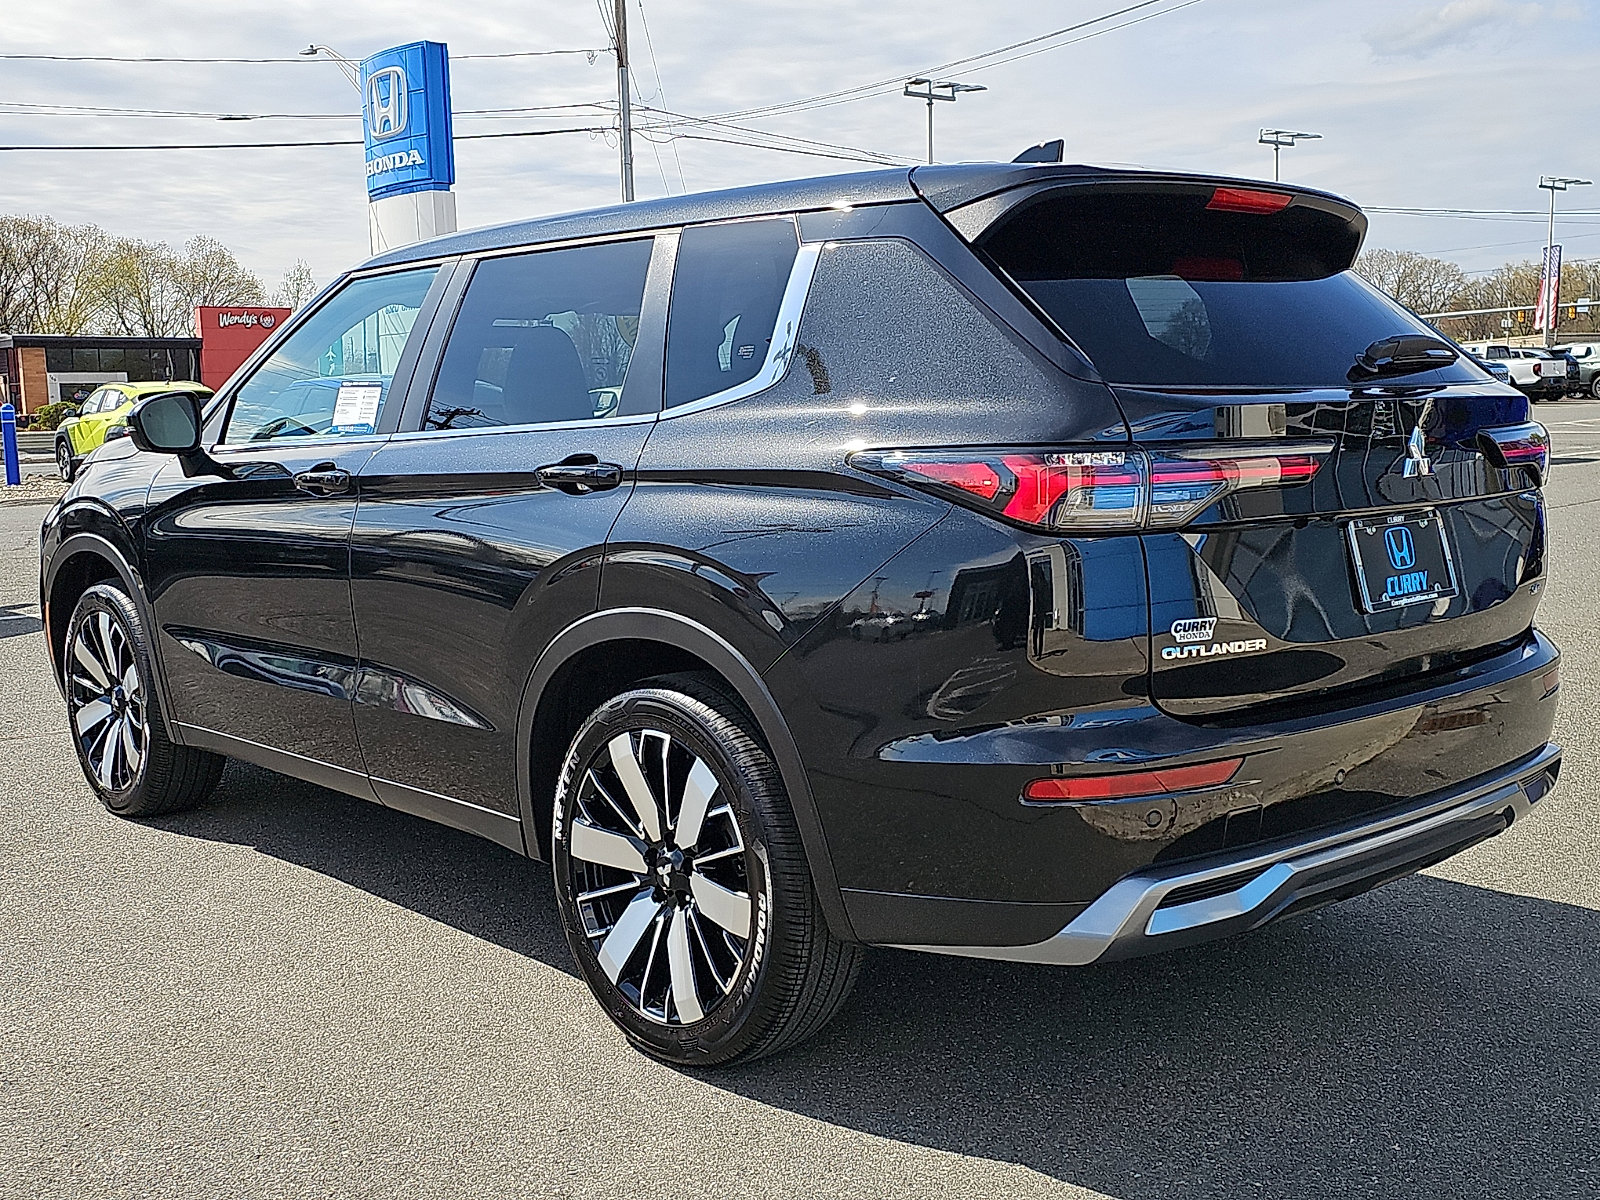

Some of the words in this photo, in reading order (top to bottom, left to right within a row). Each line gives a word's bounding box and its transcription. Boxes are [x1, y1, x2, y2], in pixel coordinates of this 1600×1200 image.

[365, 149, 425, 177] HONDA
[219, 310, 258, 328] Wendy's
[1386, 570, 1428, 597] CURRY
[1173, 619, 1215, 633] CURRY
[1178, 631, 1211, 641] HONDA
[1161, 638, 1267, 660] OUTLANDER
[555, 751, 580, 840] NEXEN
[743, 891, 767, 999] ROADIAN
